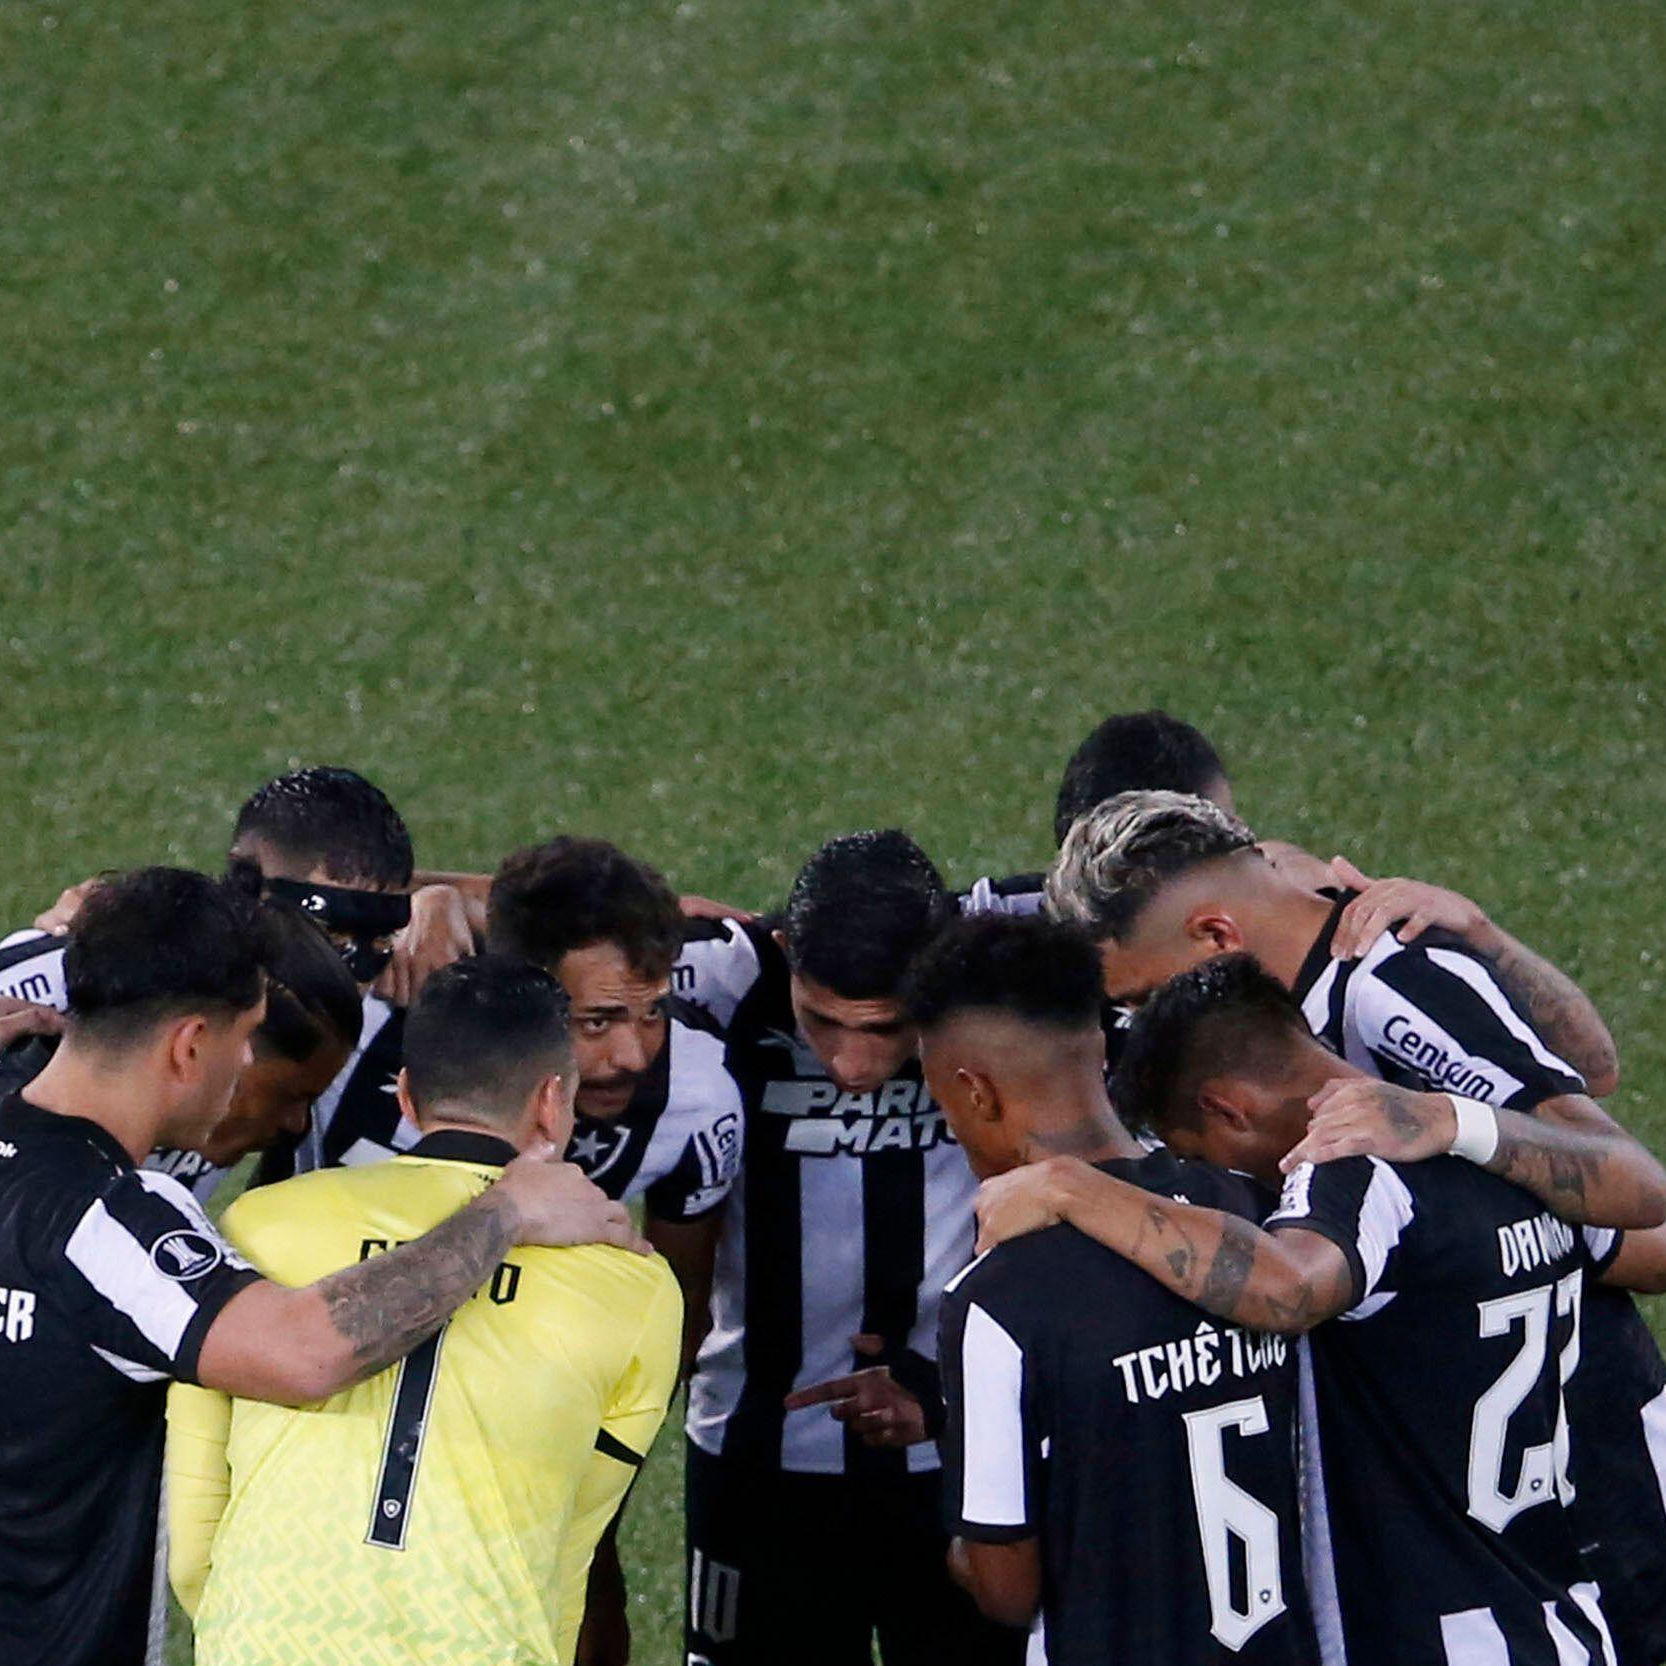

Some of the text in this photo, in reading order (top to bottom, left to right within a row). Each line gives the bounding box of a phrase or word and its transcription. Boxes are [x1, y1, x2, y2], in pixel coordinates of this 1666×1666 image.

[785, 1112, 958, 1152] MAT
[1112, 1320, 1223, 1403] TCHÊ
[1181, 1395, 1287, 1652] 6
